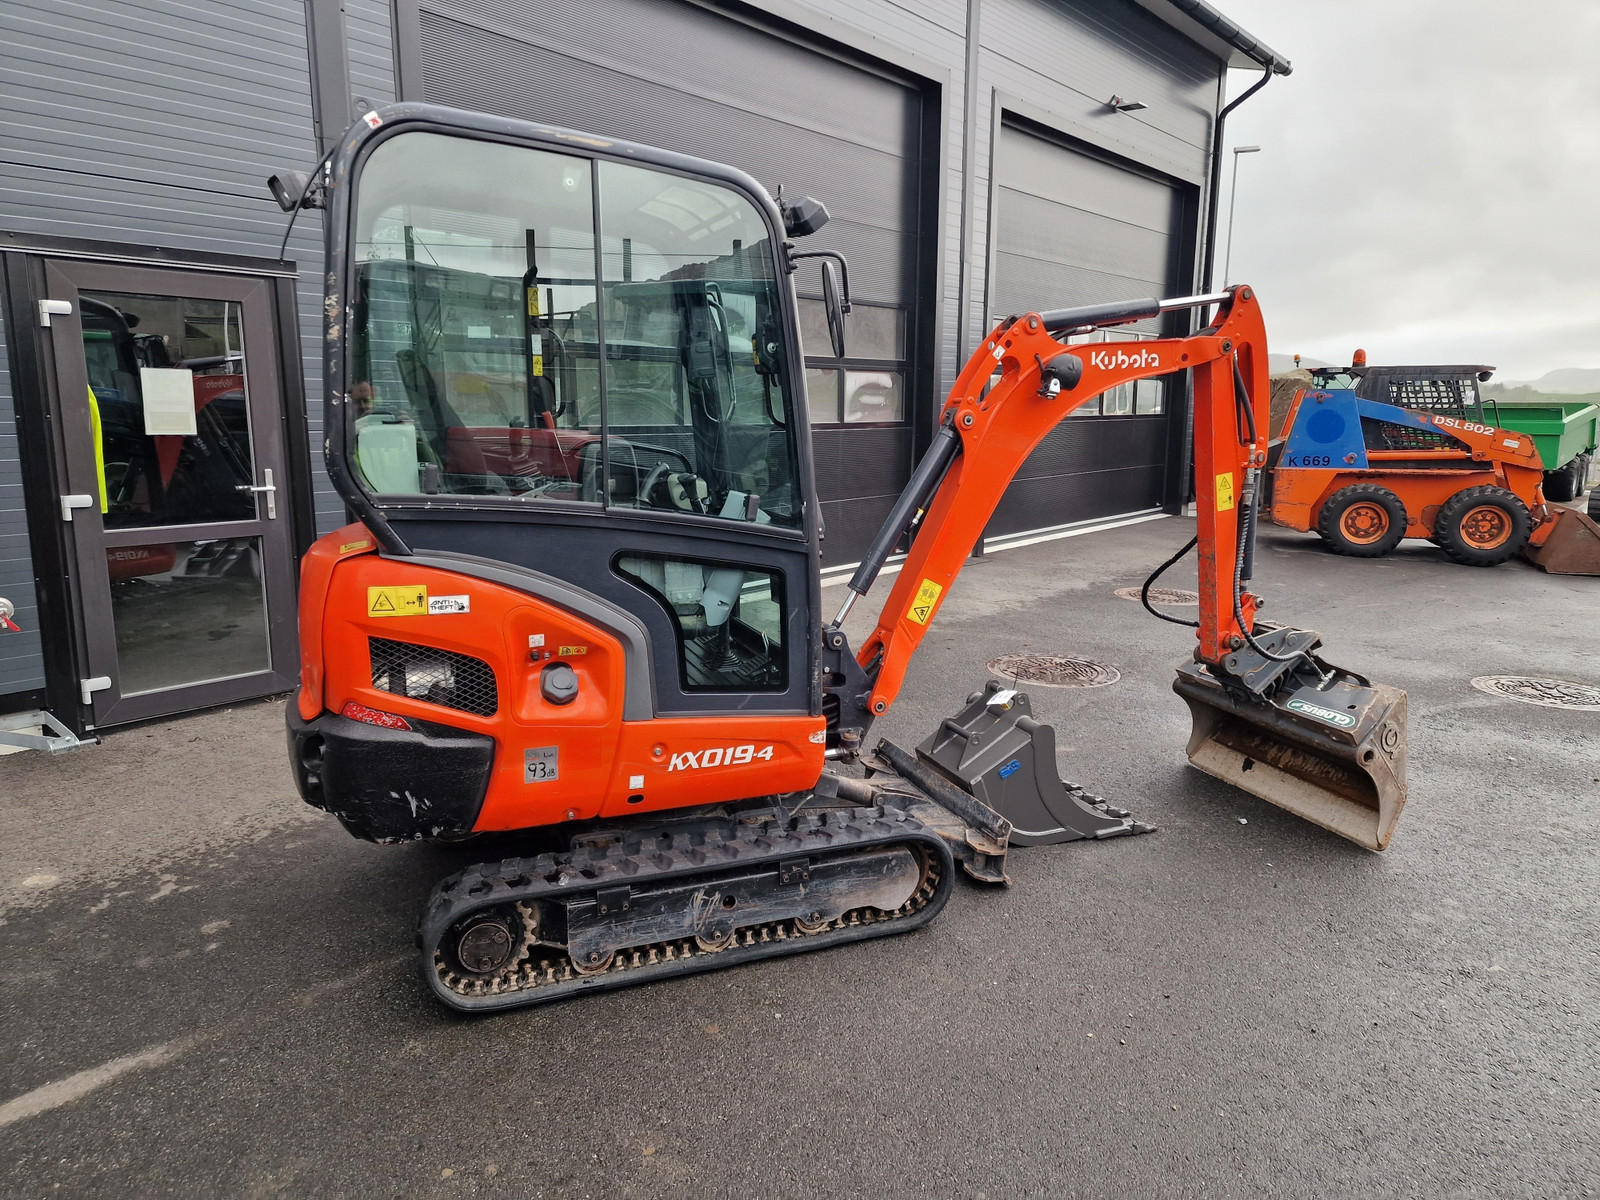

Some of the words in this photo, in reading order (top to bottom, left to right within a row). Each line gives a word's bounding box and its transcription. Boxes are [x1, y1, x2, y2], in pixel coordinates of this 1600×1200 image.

[1091, 348, 1160, 371] Kubota
[1434, 415, 1462, 429] DSL
[1463, 422, 1495, 437] 802
[1288, 456, 1298, 467] K
[1302, 455, 1331, 467] 669
[1300, 704, 1350, 724] GLOBUS
[667, 744, 774, 772] KX019-4
[528, 761, 546, 778] 93
[547, 768, 556, 777] dB
